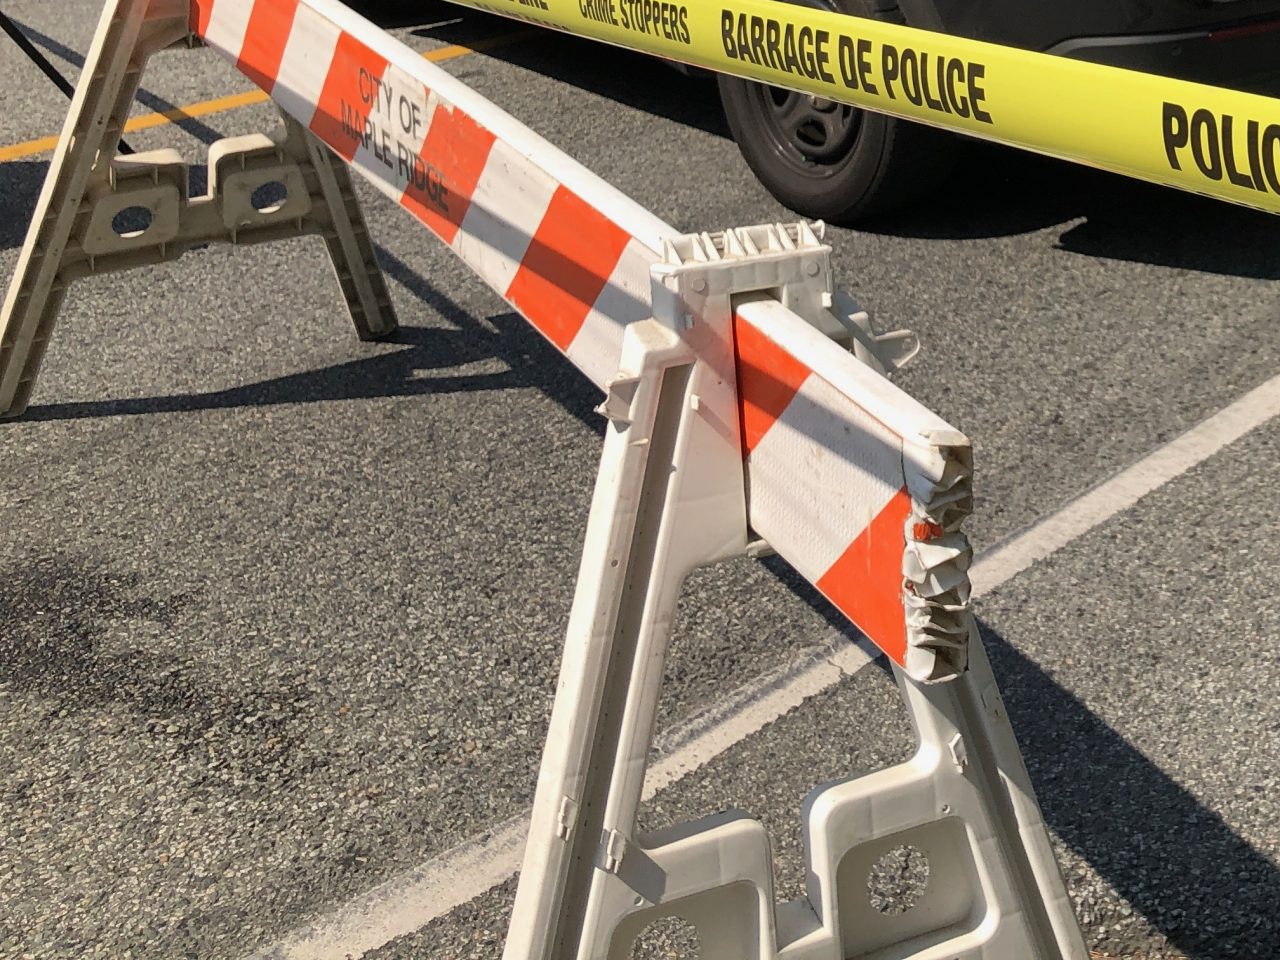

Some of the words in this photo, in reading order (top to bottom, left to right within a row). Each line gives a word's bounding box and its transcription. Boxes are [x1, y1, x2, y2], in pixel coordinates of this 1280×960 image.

[359, 67, 392, 121] CITY
[400, 94, 422, 140] OF
[721, 9, 836, 84] BARRAGE
[838, 34, 879, 96] DE
[881, 44, 994, 124] POLICE
[341, 98, 394, 170] MAPLE
[397, 140, 449, 213] RIDGE
